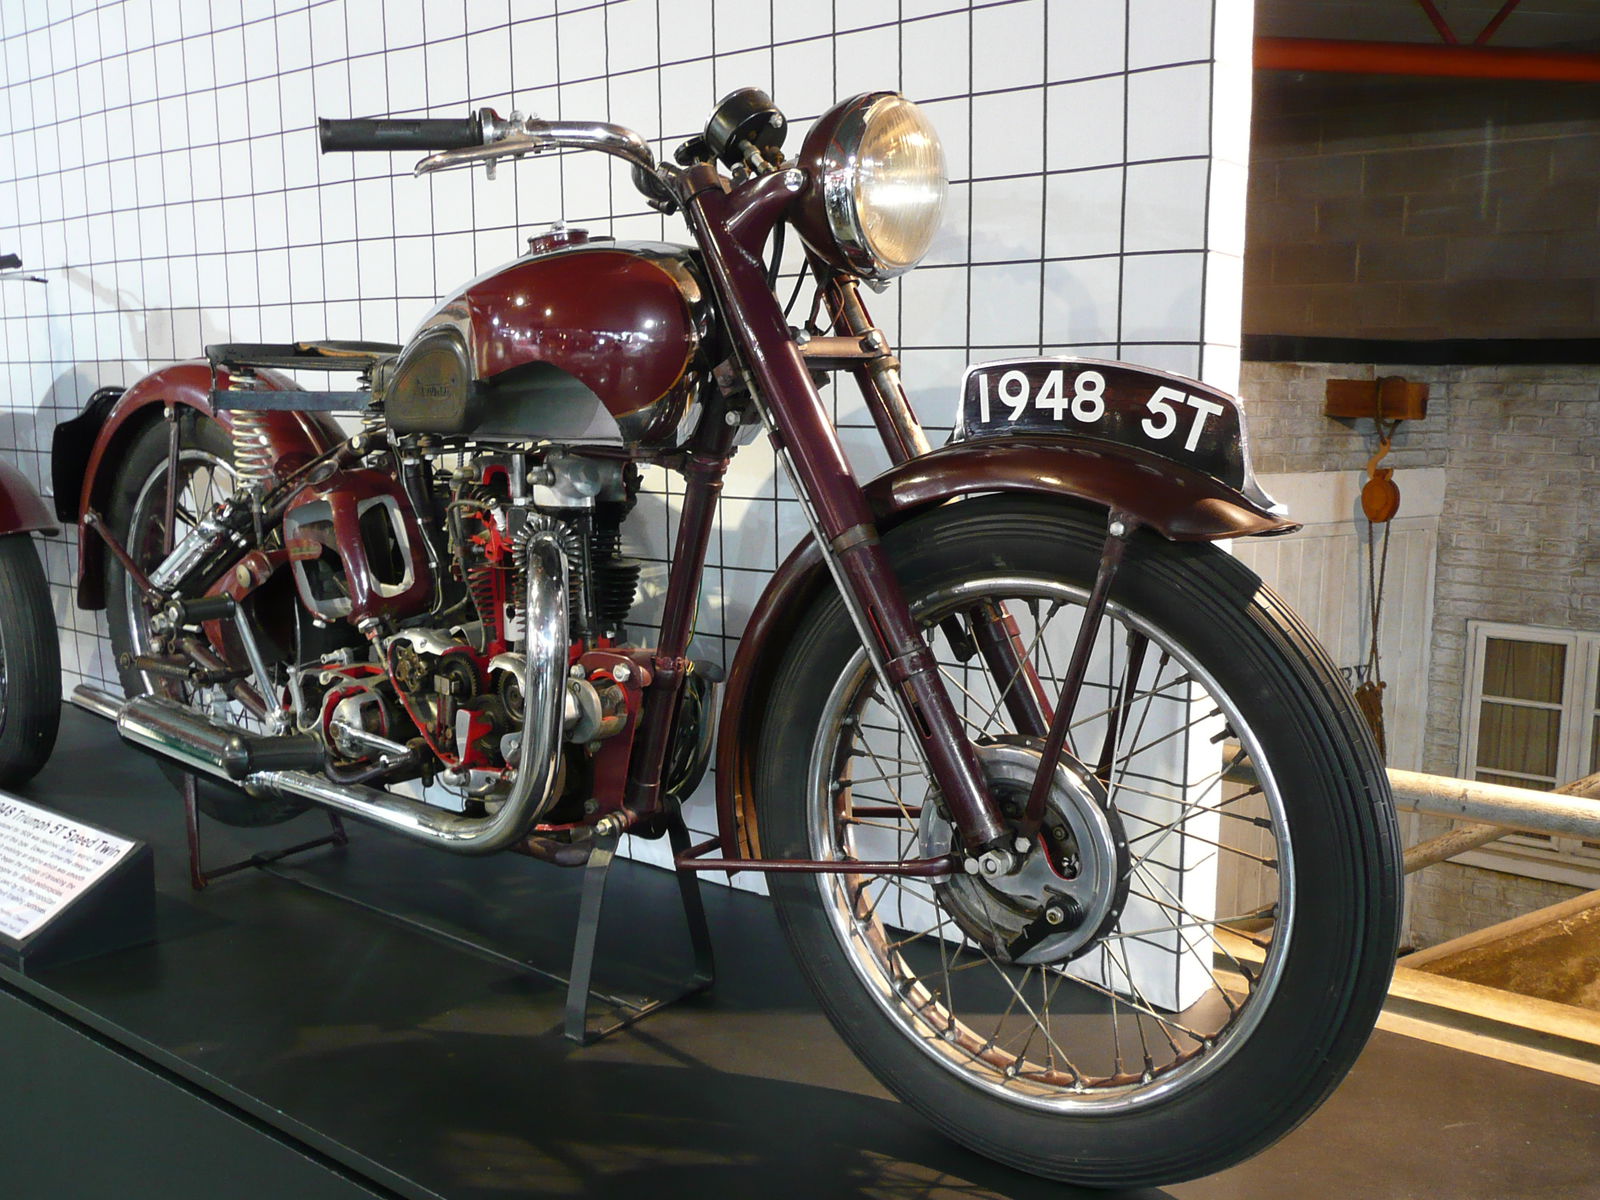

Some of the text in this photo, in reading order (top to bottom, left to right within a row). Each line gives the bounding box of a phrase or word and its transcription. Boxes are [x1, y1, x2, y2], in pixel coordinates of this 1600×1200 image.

[979, 369, 1224, 452] 1948 5T
[12, 809, 51, 831] Triumph
[49, 823, 68, 836] 5T
[62, 829, 100, 848] Speed
[95, 840, 121, 857] Twin
